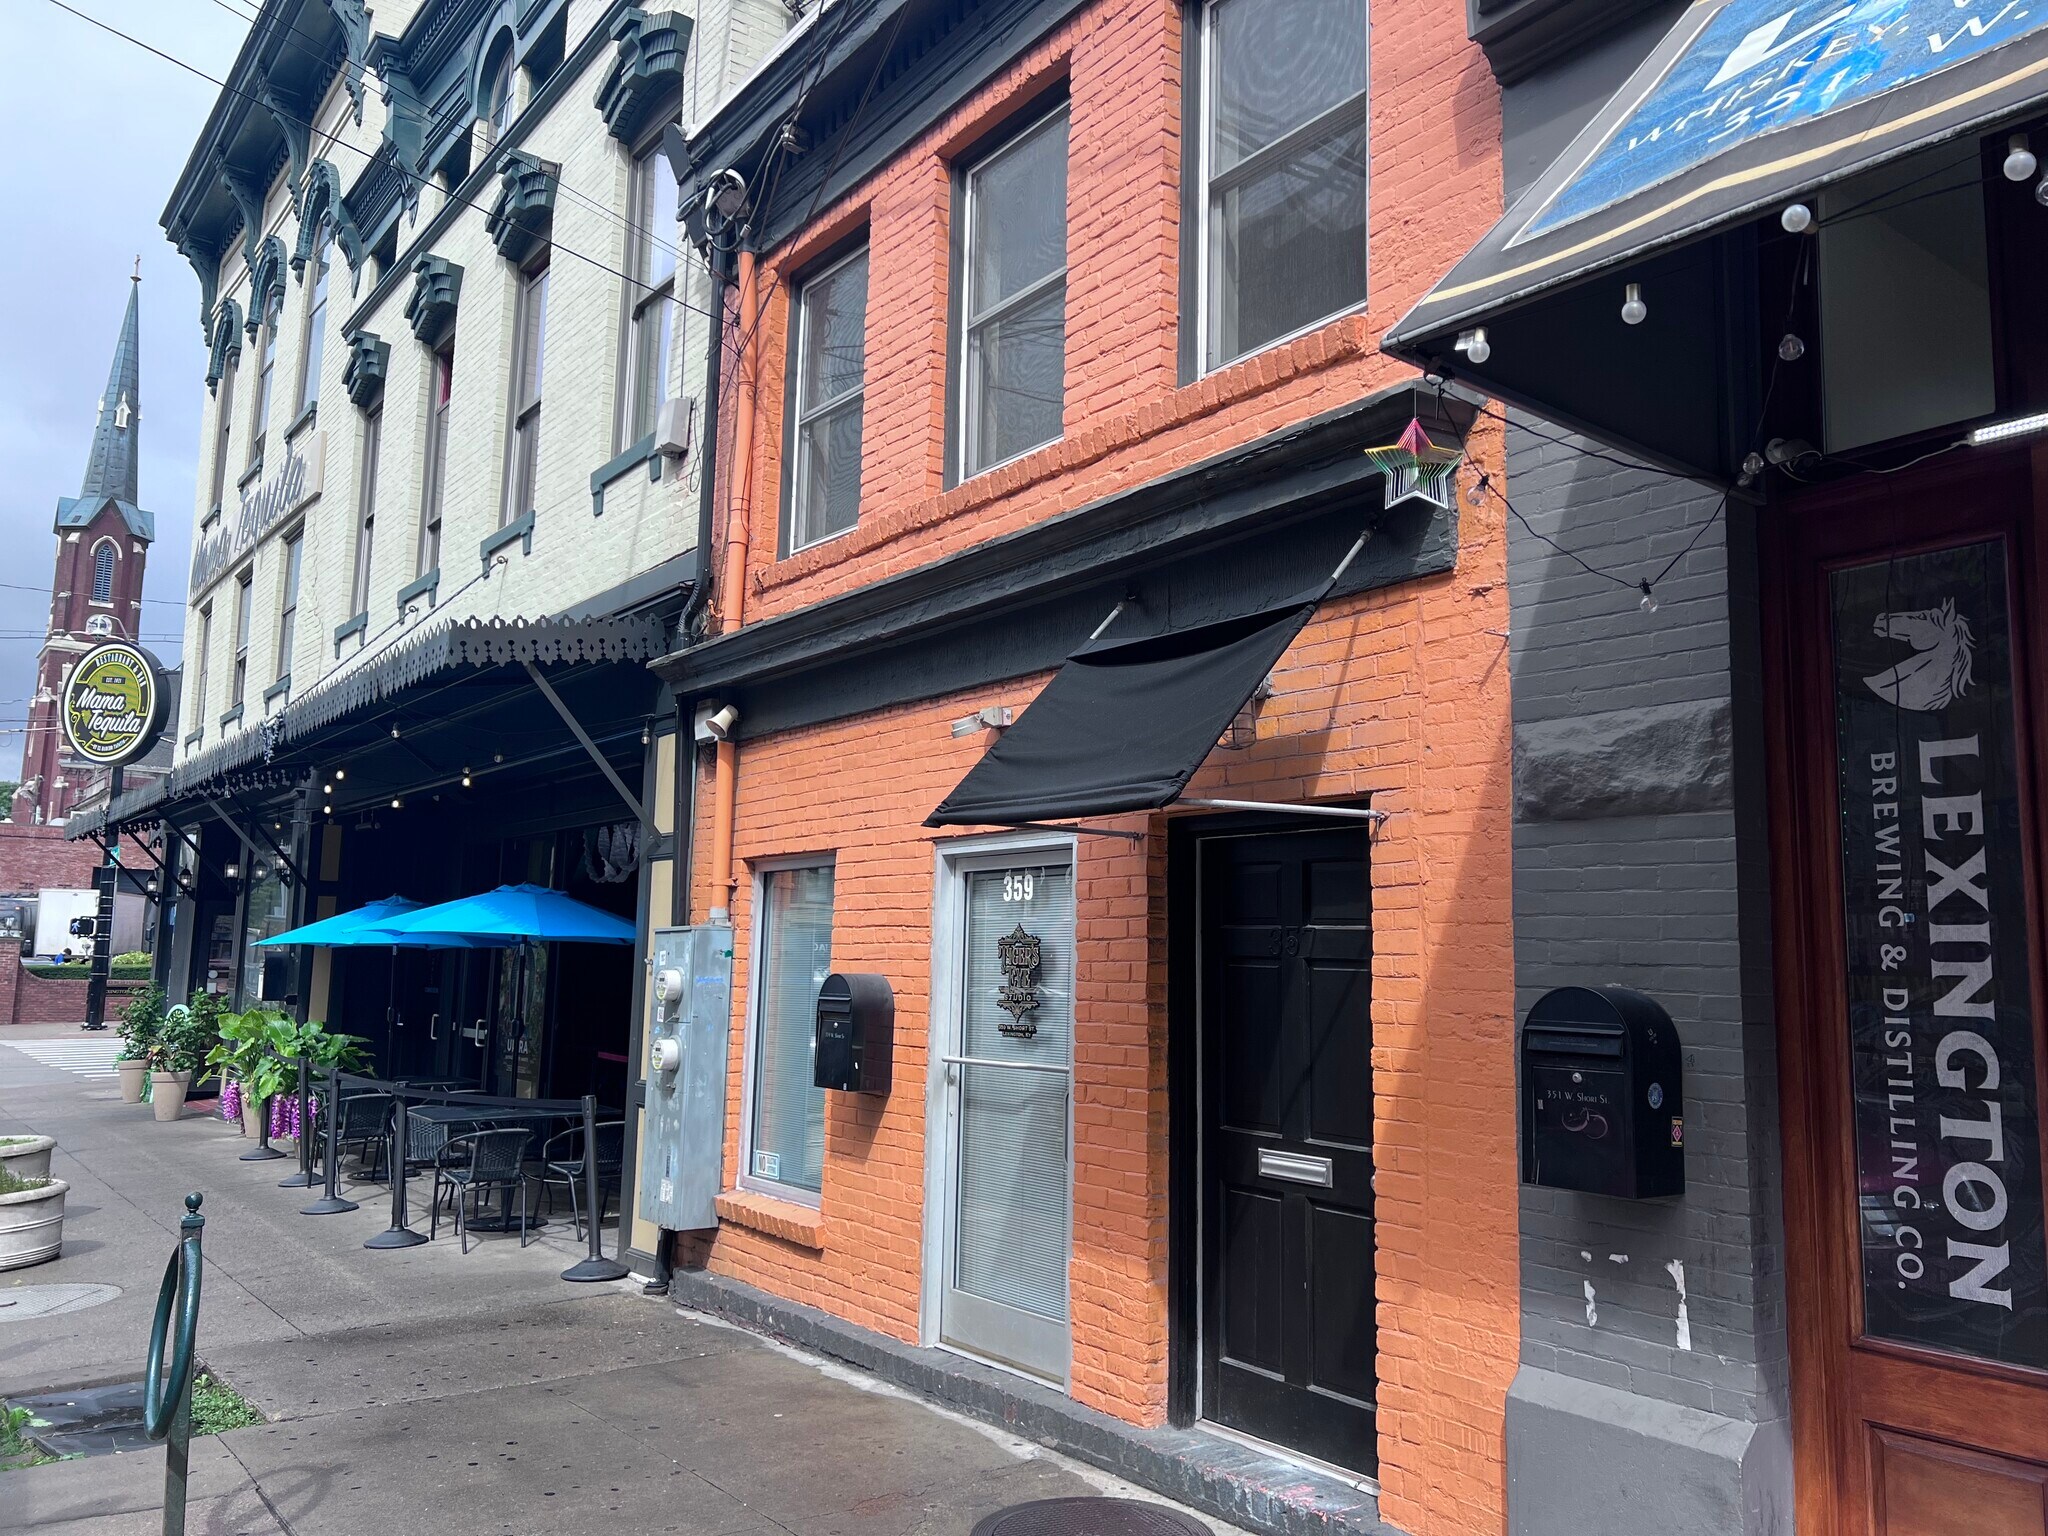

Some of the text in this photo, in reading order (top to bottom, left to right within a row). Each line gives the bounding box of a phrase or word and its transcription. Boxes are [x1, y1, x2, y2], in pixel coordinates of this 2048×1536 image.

[76, 687, 125, 710] Mama
[87, 709, 141, 738] Tequila
[1003, 874, 1034, 902] 359
[1870, 751, 1925, 1290] BREWING & DISTILLING CO.
[1918, 733, 2013, 1311] LEXINGTON
[1547, 1090, 1562, 1099] 351
